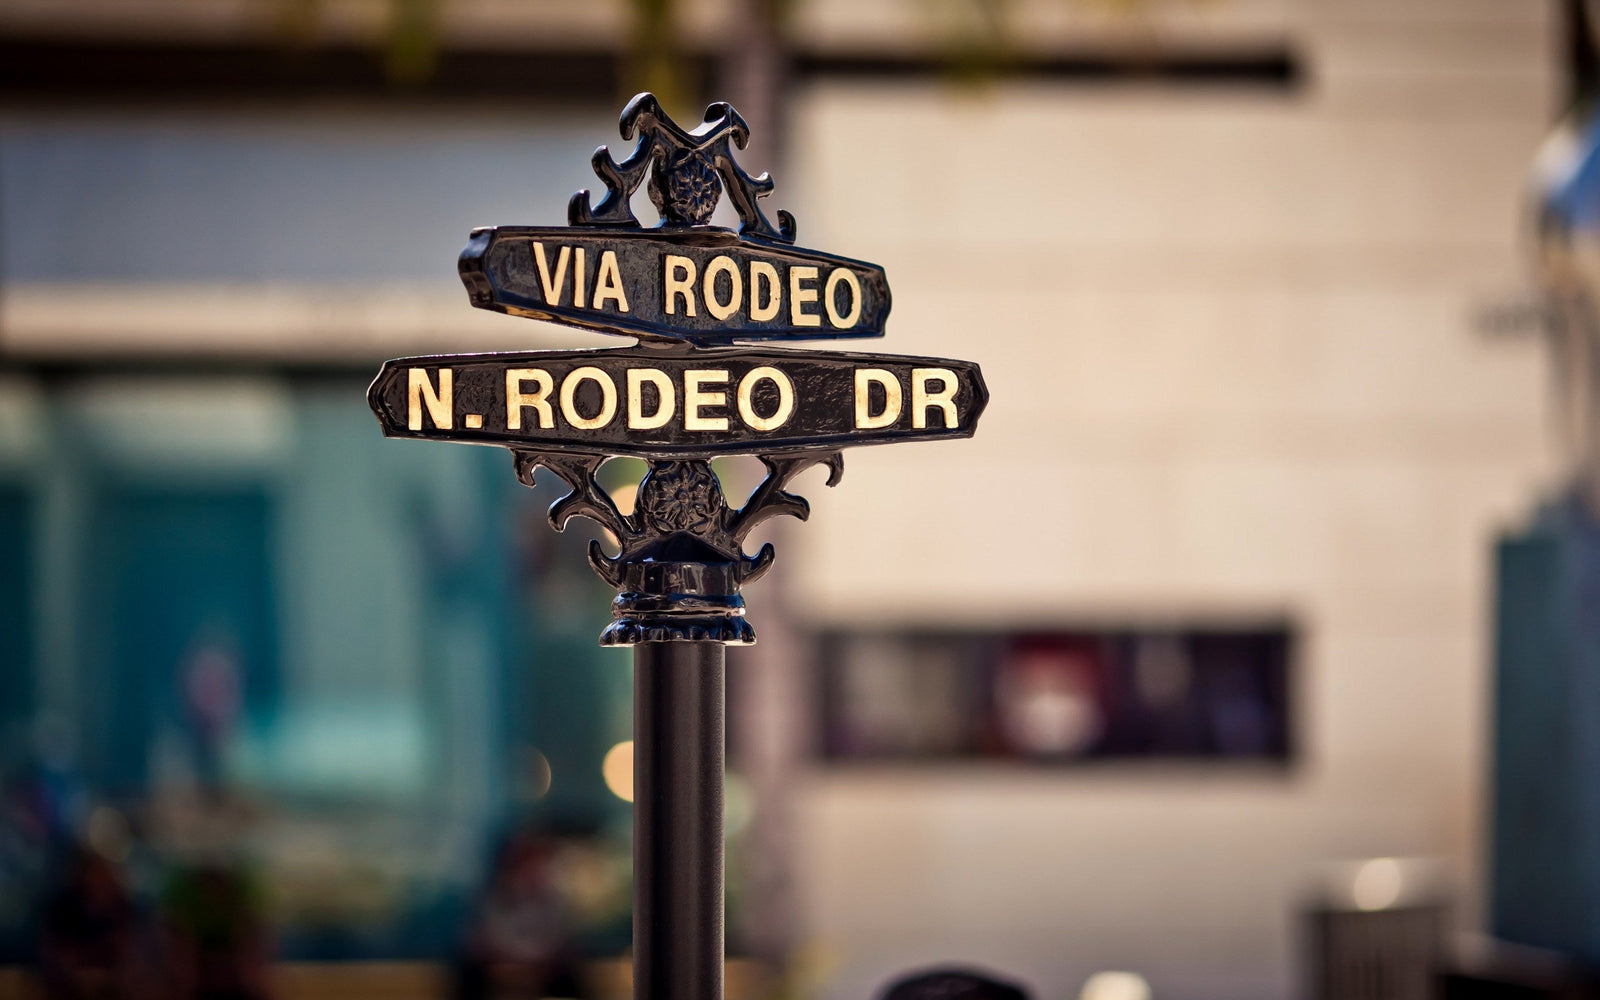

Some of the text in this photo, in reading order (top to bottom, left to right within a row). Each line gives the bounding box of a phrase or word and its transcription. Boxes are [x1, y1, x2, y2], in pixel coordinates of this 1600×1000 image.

[532, 241, 862, 329] VIA RODEO
[408, 366, 959, 431] N. RODEO DR
